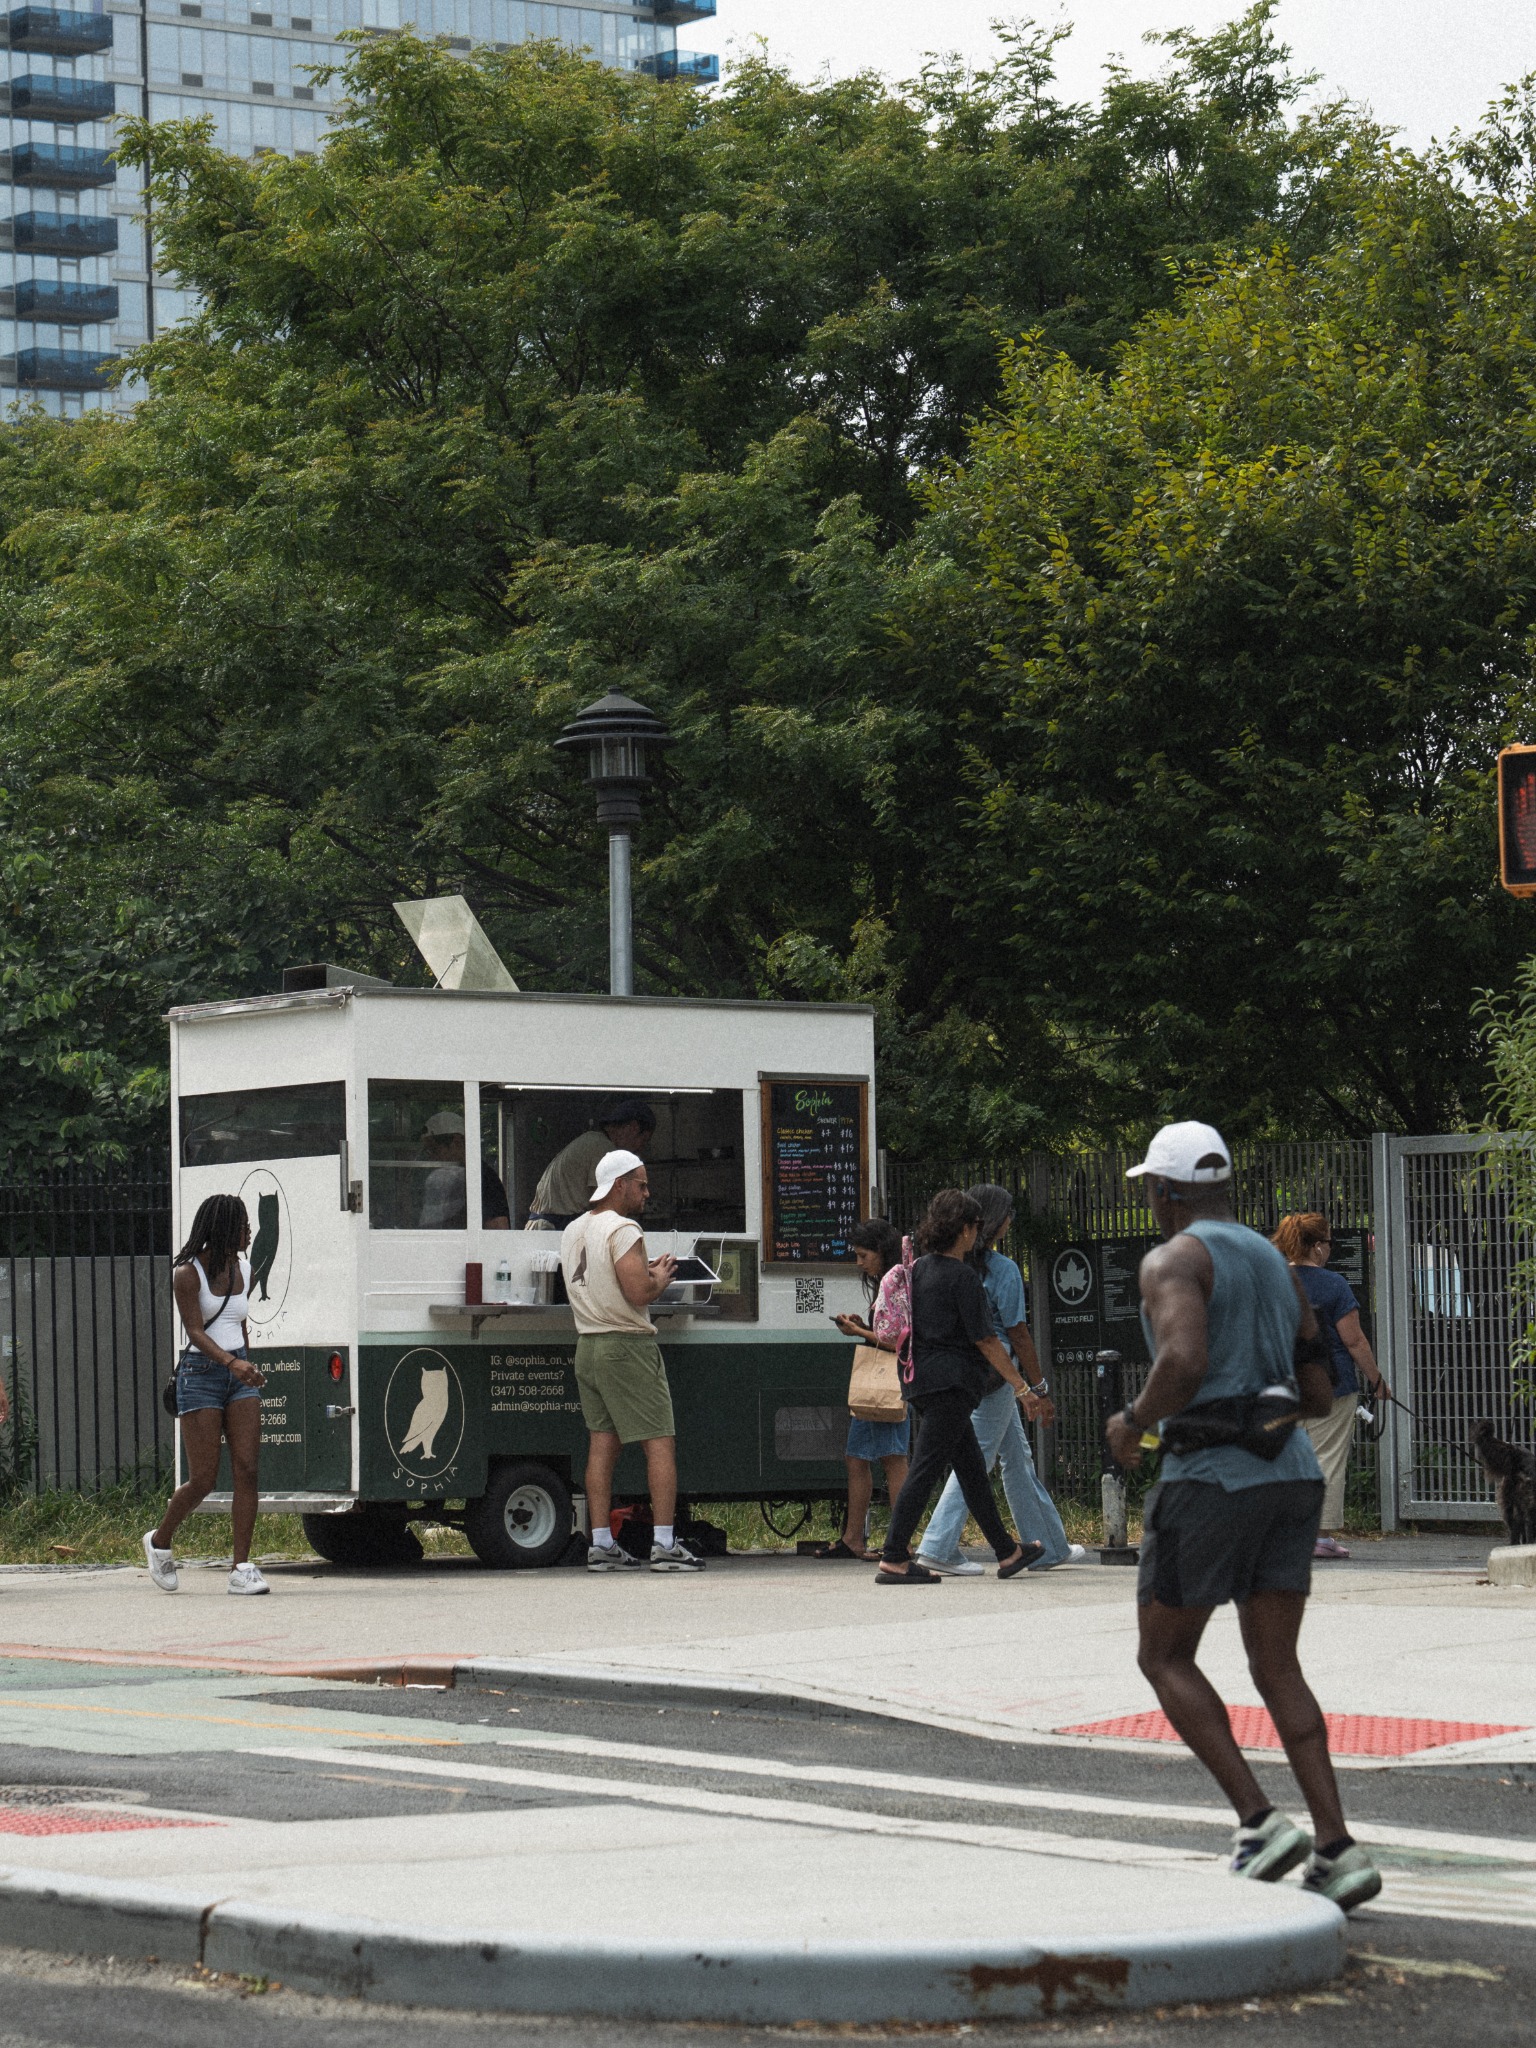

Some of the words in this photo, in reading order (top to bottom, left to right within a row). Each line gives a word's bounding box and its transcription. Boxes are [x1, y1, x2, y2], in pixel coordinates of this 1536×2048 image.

[840, 1128, 853, 1138] $16
[840, 1143, 855, 1153] $15
[1055, 1315, 1079, 1324] ATHLETIC
[1079, 1314, 1094, 1323] FIELD
[490, 1355, 502, 1366] IG:
[505, 1355, 576, 1367] @sophia_on_w
[490, 1370, 525, 1381] Private
[528, 1370, 565, 1380] events?
[490, 1385, 515, 1396] (347)
[518, 1385, 565, 1396] 508-2668
[491, 1401, 582, 1413] admin@sophia-nyc
[260, 1413, 287, 1426] 8-2668
[392, 1467, 459, 1494] SOPHIA
